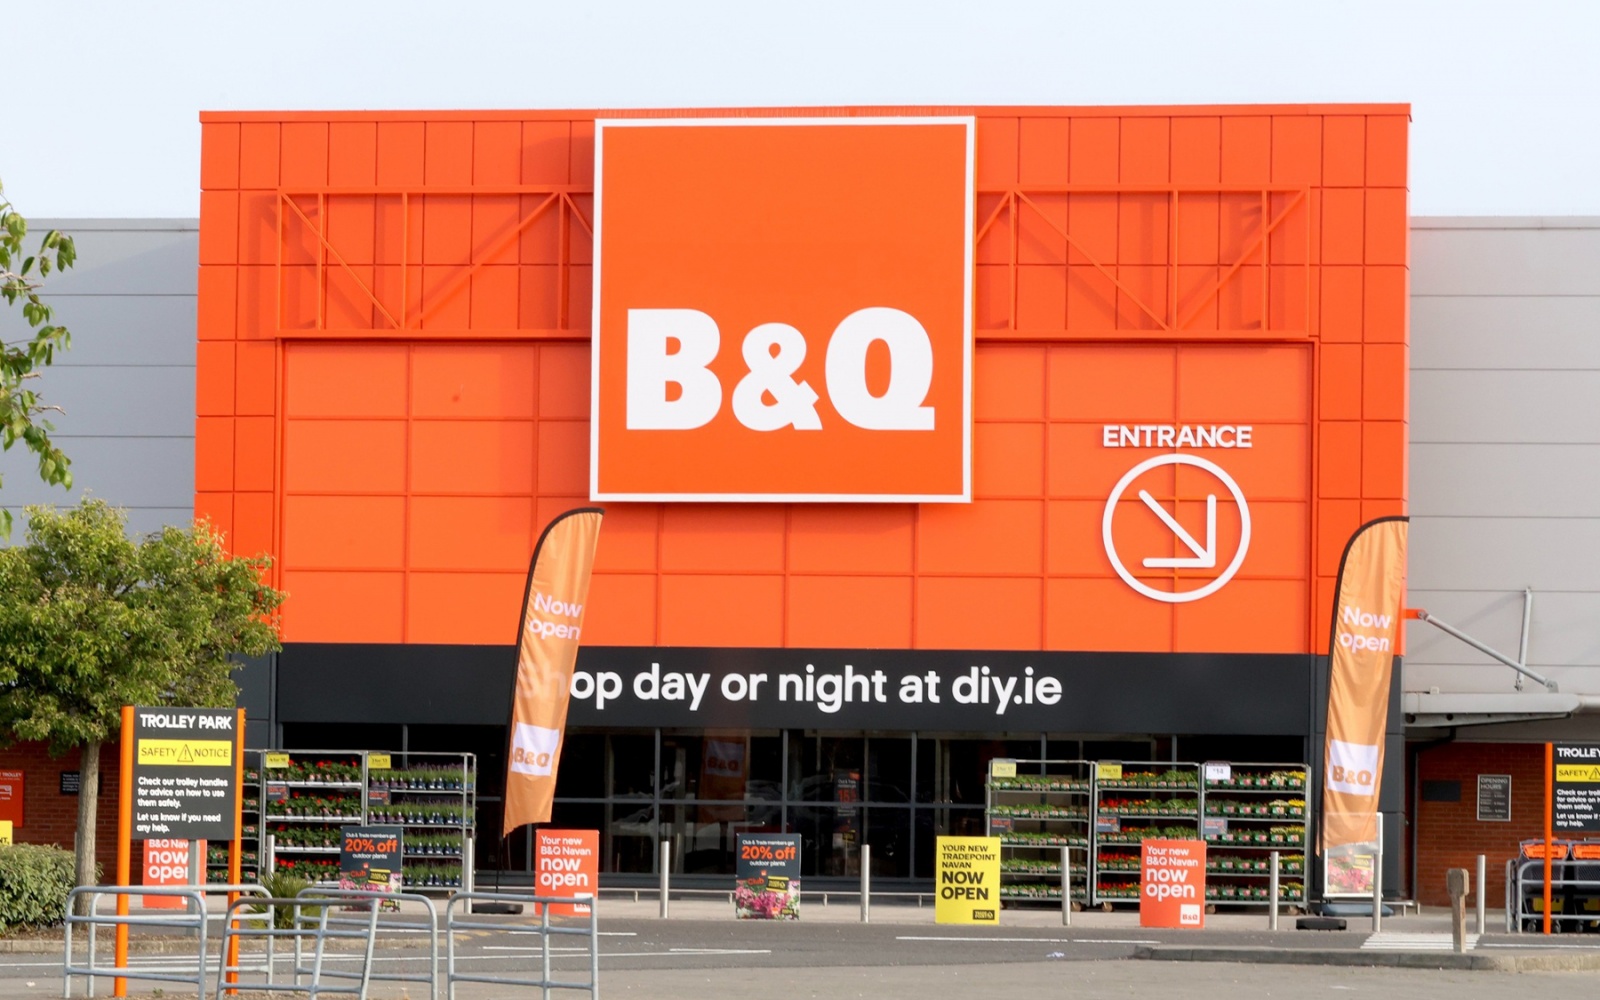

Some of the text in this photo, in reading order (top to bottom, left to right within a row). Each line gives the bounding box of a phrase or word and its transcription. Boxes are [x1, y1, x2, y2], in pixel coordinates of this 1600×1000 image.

[626, 307, 935, 432] B&Q
[1103, 425, 1252, 448] ENTRANCE
[534, 592, 582, 617] Now
[1343, 605, 1391, 630] Now
[529, 619, 580, 641] open
[1340, 631, 1390, 654] open
[633, 662, 711, 711] day
[720, 673, 768, 702] or
[779, 664, 887, 713] night
[898, 670, 941, 703] at
[952, 666, 1062, 715] diy.ie
[140, 714, 232, 730] TROLLEY PARK
[141, 748, 229, 758] SAFETY NOTICE
[514, 746, 549, 768] B&Q
[1332, 764, 1372, 786] B&Q
[138, 777, 161, 786] Check
[176, 778, 198, 788] trolley
[199, 778, 228, 787] handles
[138, 788, 148, 796] for
[149, 788, 174, 796] advice
[186, 789, 201, 797] how
[138, 798, 181, 808] them safely.
[137, 812, 149, 821] Let
[160, 813, 180, 822] know
[181, 813, 188, 822] if
[203, 814, 221, 822] need
[137, 824, 170, 834] any help.
[148, 839, 188, 848] B&Q Nav
[345, 839, 397, 852] 20% off
[541, 836, 561, 845] Your
[541, 846, 591, 856] B&Q Navan
[742, 846, 796, 860] 20% off
[1147, 846, 1167, 855] Your
[148, 851, 188, 864] now
[1146, 856, 1198, 866] B&Q Navan
[541, 858, 581, 871] now
[540, 872, 588, 890] open
[747, 877, 764, 885] Club
[942, 871, 984, 884] NOW
[1146, 868, 1188, 882] now
[941, 887, 988, 900] OPEN
[1146, 884, 1195, 902] open
